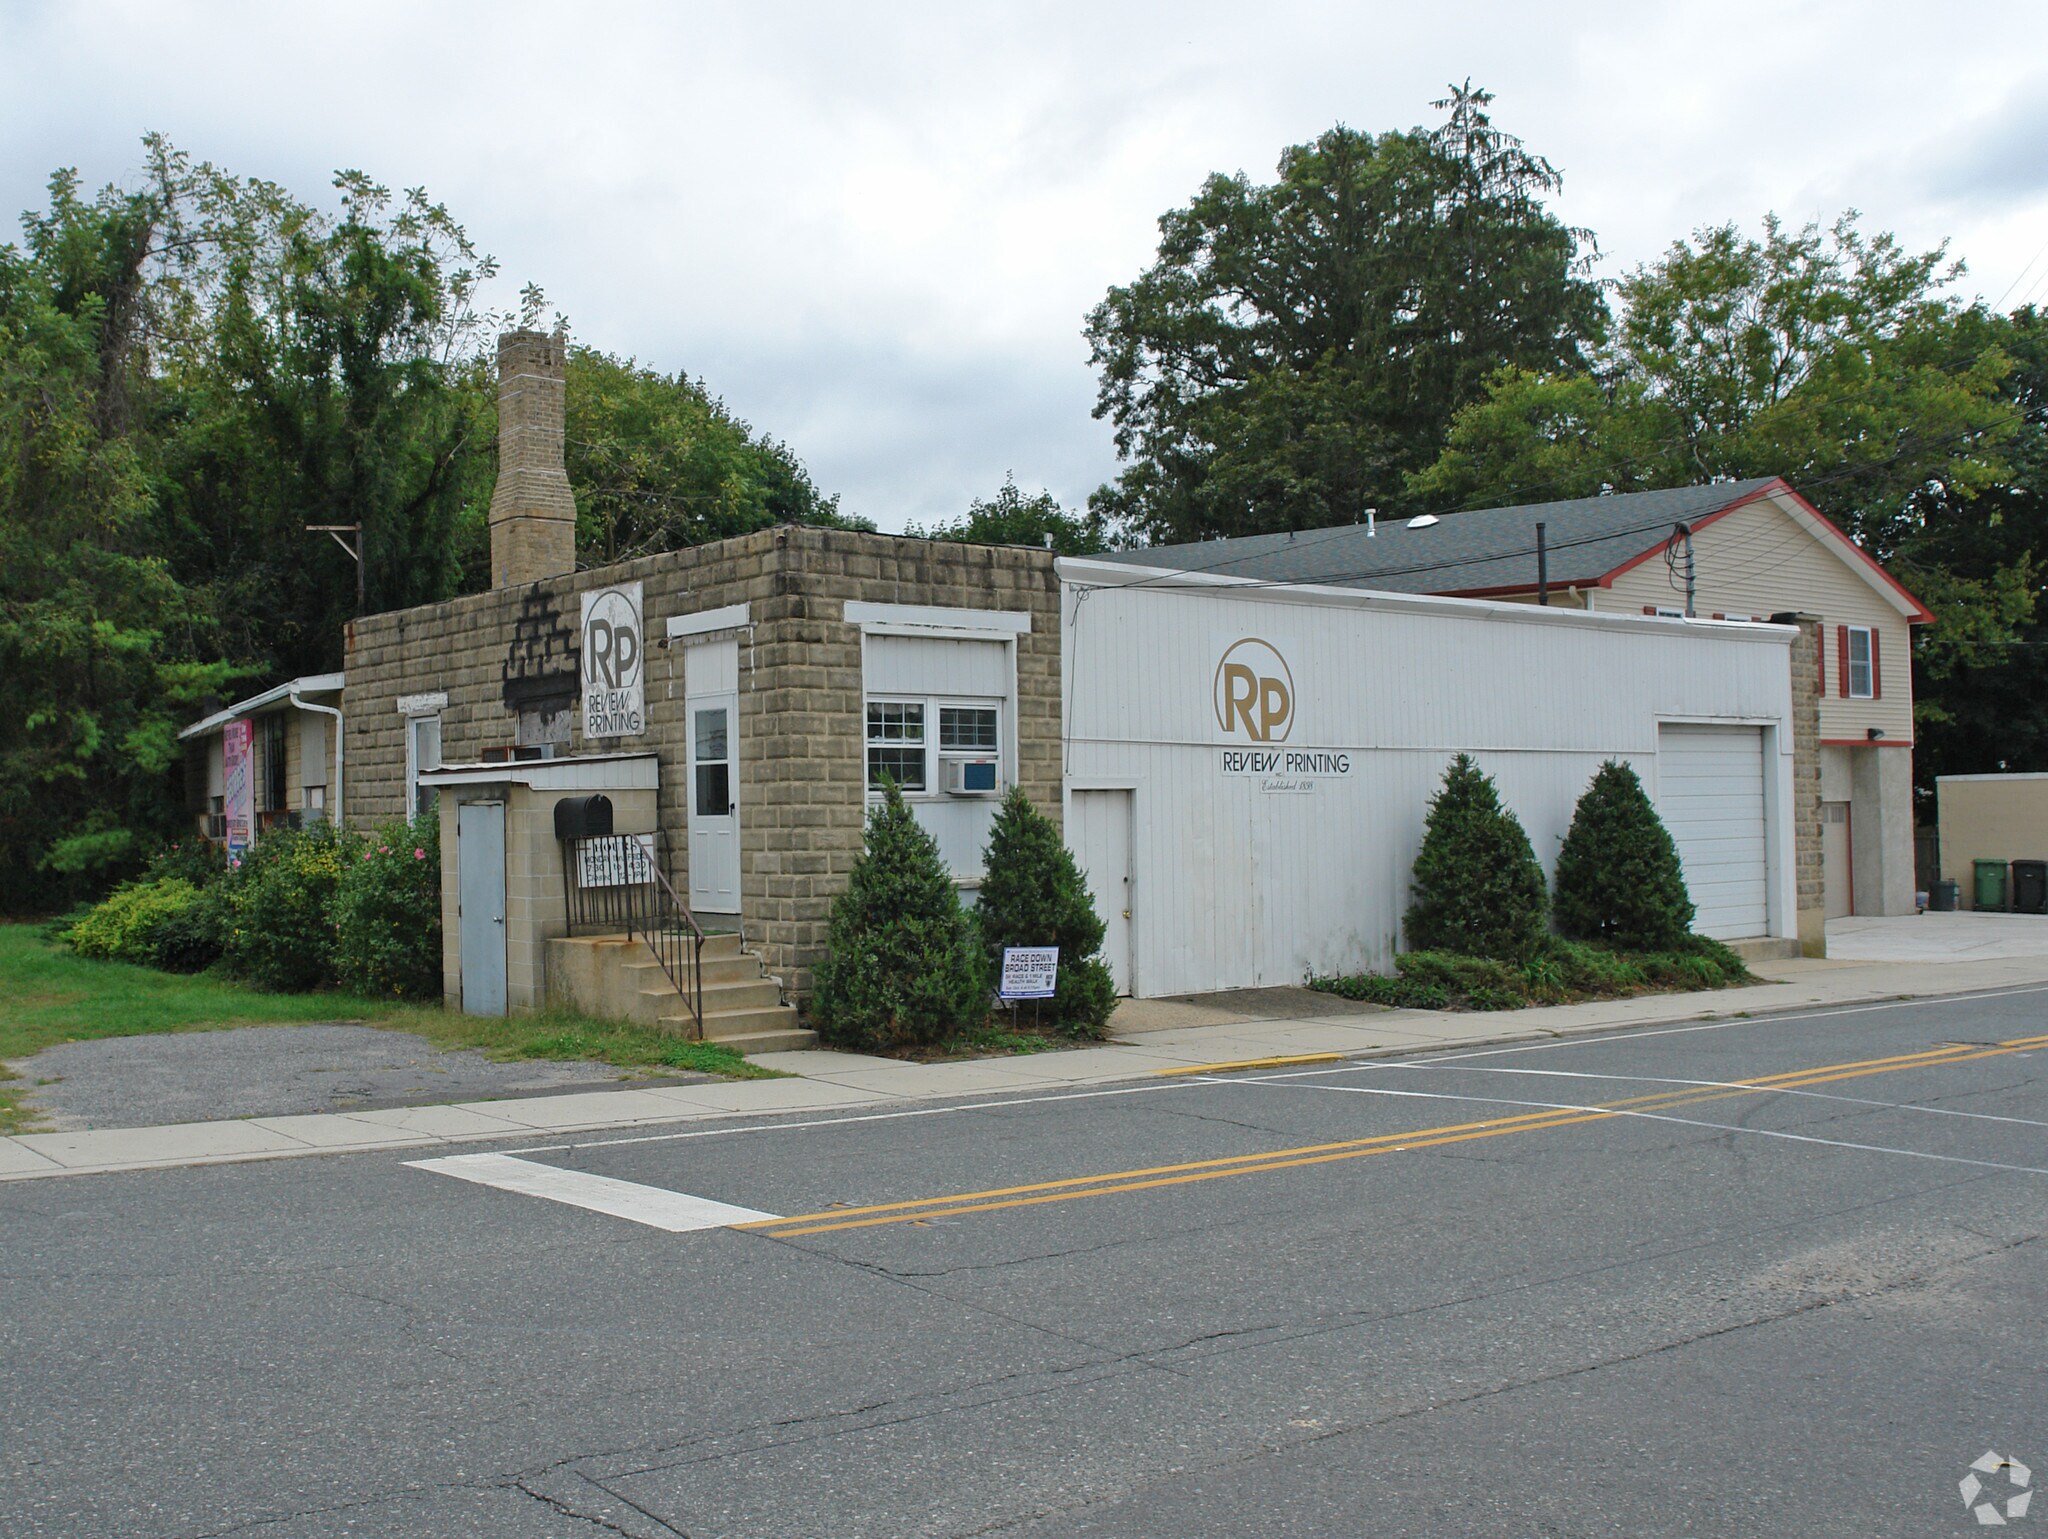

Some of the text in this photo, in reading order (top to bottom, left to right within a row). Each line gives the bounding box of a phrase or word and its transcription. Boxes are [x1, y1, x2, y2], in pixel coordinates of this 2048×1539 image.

[589, 618, 637, 690] RP
[589, 690, 630, 713] REVIEW
[1224, 663, 1290, 742] RP
[589, 711, 640, 734] PRINTING
[1223, 751, 1351, 774] REVIEW PRINTING
[1005, 963, 1056, 972] BROAD STREET
[1011, 953, 1052, 963] RACE DOWN
